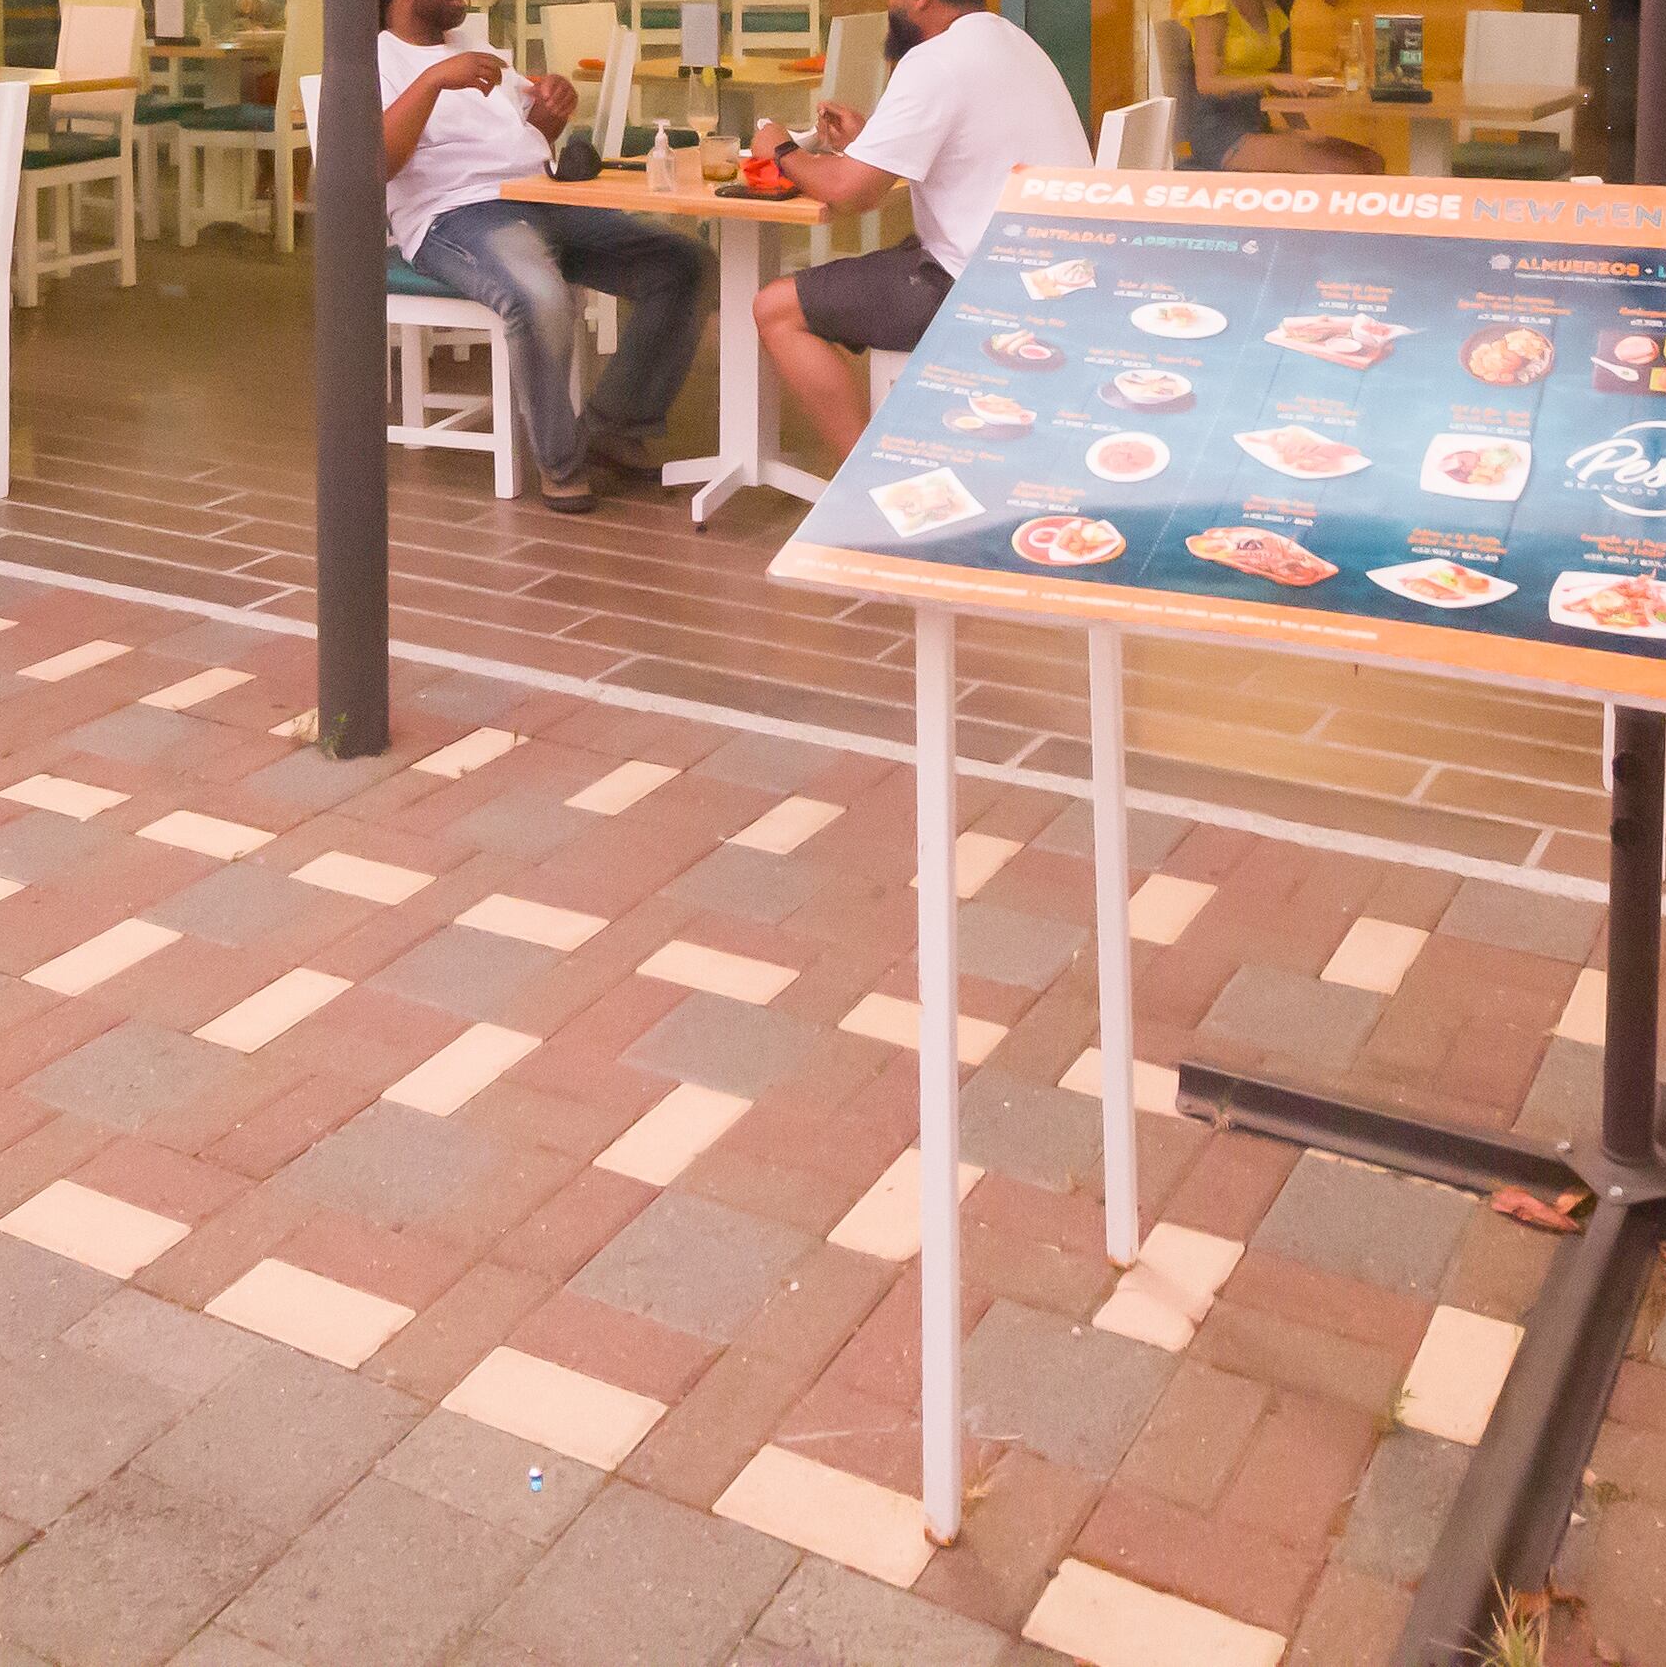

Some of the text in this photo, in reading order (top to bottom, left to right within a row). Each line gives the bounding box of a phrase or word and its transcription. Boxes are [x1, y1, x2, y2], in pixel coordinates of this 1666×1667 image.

[1021, 178, 1135, 207] PESCA
[1143, 184, 1321, 214] SEAFOOD
[1328, 190, 1462, 220] HOUSE
[1473, 197, 1565, 225] NEW
[1026, 226, 1239, 254] ENTRADAS APPETIZERS
[1516, 257, 1641, 278] ALMUERZOS
